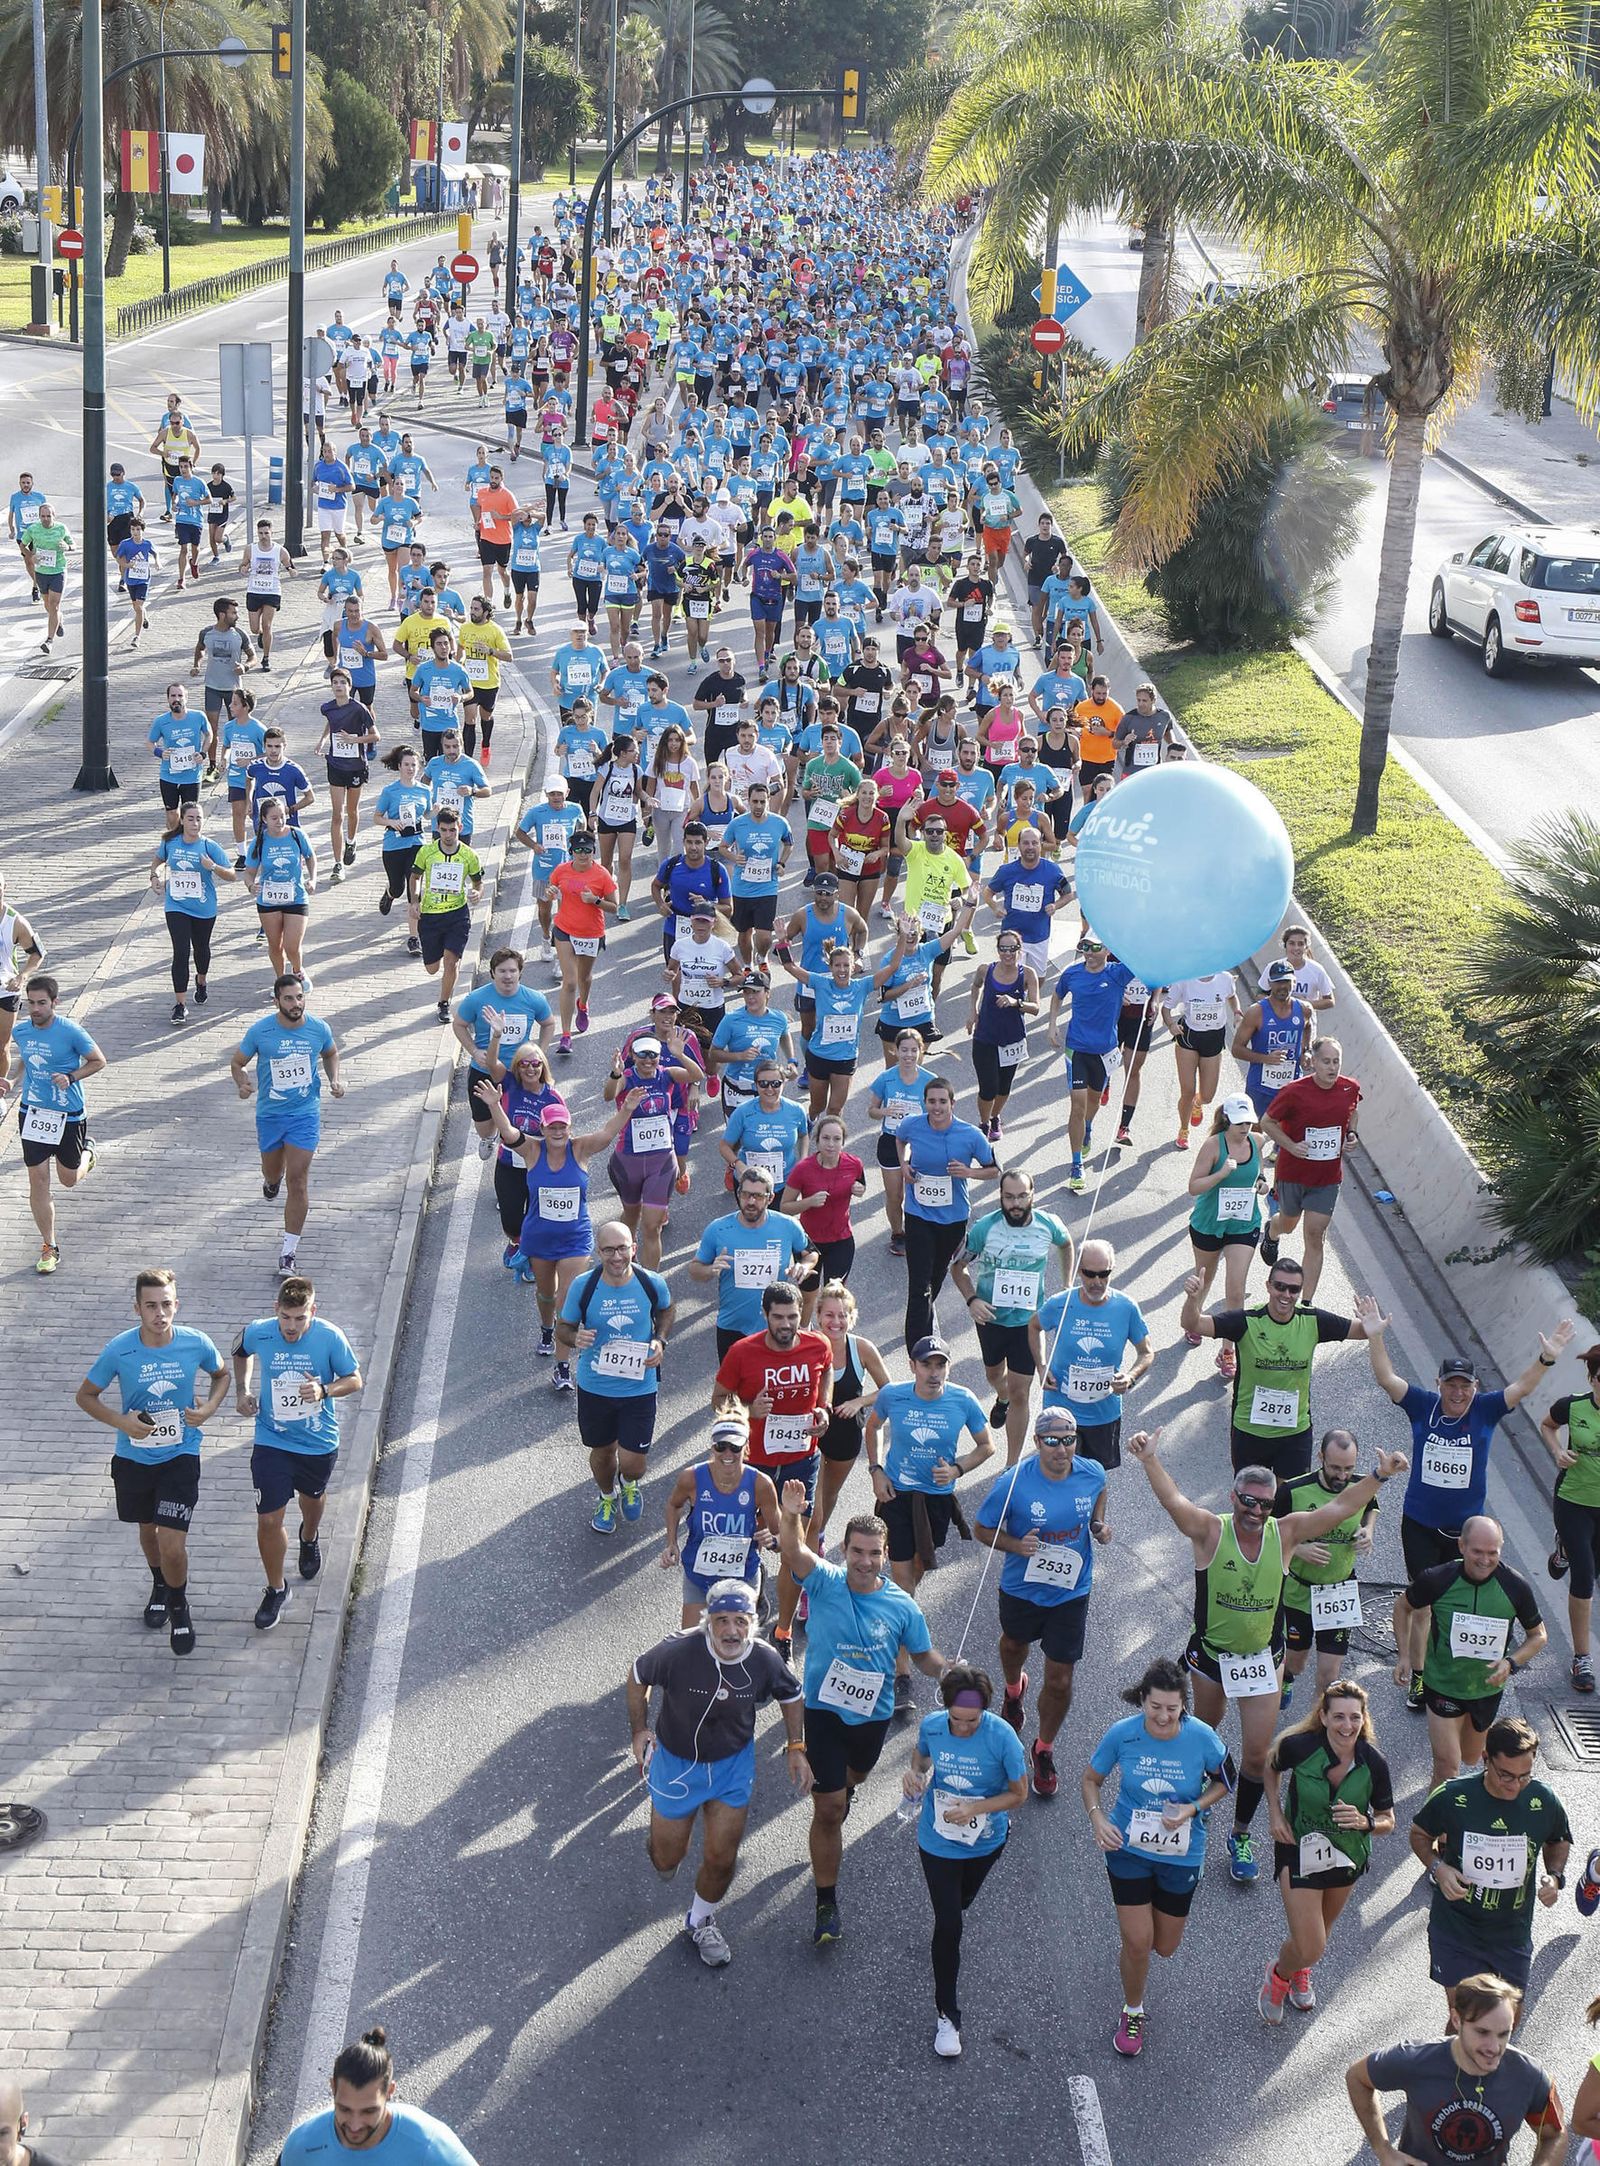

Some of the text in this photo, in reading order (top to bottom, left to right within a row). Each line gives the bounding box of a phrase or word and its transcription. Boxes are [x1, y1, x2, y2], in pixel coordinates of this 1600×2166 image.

[1057, 295, 1080, 303] SICA
[433, 696, 451, 704] 8095
[718, 711, 737, 719] 15108
[174, 754, 192, 763] 3418
[235, 749, 253, 758] 8503
[1138, 751, 1154, 759] 1111
[572, 760, 591, 770] 6211
[440, 797, 459, 806] 2941
[610, 805, 629, 814] 2730
[814, 806, 832, 819] 8203
[545, 832, 563, 842] 1861
[436, 871, 458, 882] 3432
[747, 866, 769, 876] 18578
[174, 880, 197, 890] 9179
[266, 890, 289, 900] 9178
[1014, 894, 1040, 904] 18933
[573, 939, 594, 949] 6073
[684, 988, 712, 998] 13422
[904, 996, 925, 1008] 1682
[1195, 1012, 1218, 1021] 8298
[503, 1026, 521, 1035] 093
[829, 1023, 852, 1034] 1314
[1268, 1030, 1299, 1045] RCM
[1004, 1046, 1024, 1057] 1317
[279, 1066, 305, 1079] 3313
[1265, 1069, 1293, 1080] 15002
[30, 1119, 58, 1134] 6393
[638, 1128, 665, 1140] 6076
[1311, 1139, 1337, 1149] 3795
[919, 1185, 946, 1197] 2695
[546, 1199, 573, 1210] 3690
[1225, 1200, 1249, 1211] 9257
[741, 1264, 772, 1276] 3274
[1001, 1284, 1031, 1297] 6116
[604, 1352, 642, 1368] 18711
[764, 1364, 810, 1386] RCM
[1072, 1380, 1110, 1392] 18709
[281, 1395, 304, 1407] 327
[1260, 1401, 1292, 1415] 2878
[150, 1425, 177, 1437] 296
[768, 1428, 808, 1440] 18435
[1426, 1459, 1467, 1475] 18669
[701, 1510, 746, 1534] RCM
[702, 1551, 743, 1565] 18436
[1036, 1558, 1073, 1575] 2533
[1315, 1598, 1356, 1615] 15637
[1459, 1632, 1498, 1647] 9337
[1229, 1664, 1267, 1682] 6438
[830, 1676, 875, 1701] 13008
[1473, 1855, 1515, 1872] 6911
[1445, 2149, 1476, 2161] SPRINT
